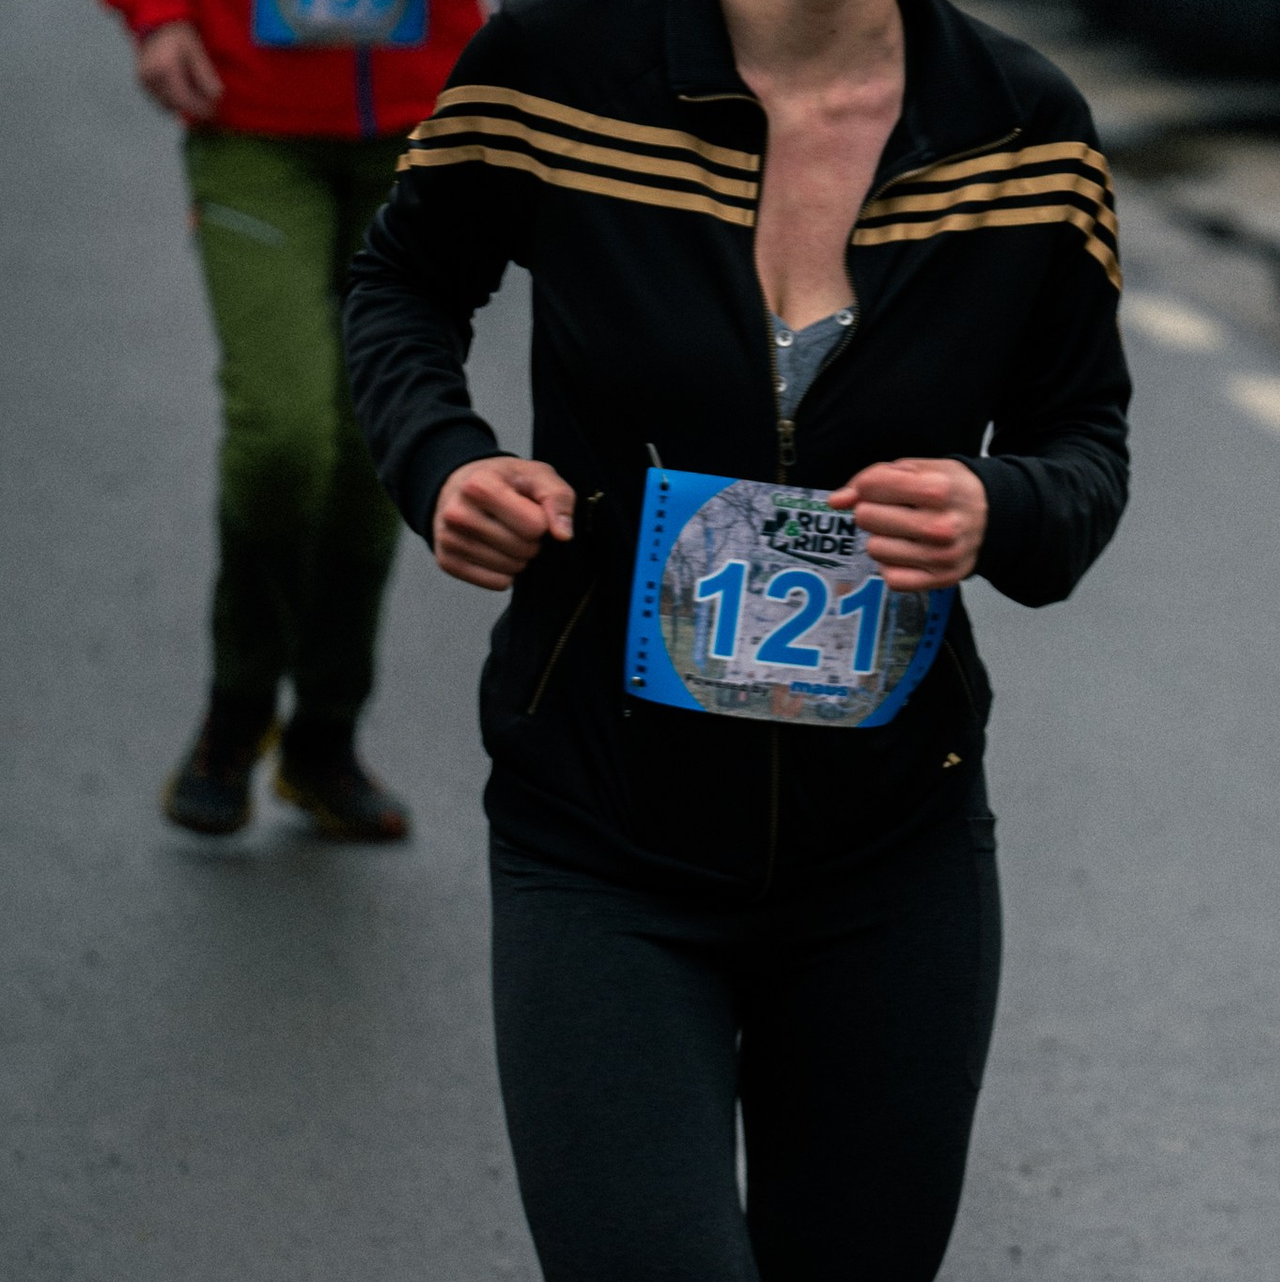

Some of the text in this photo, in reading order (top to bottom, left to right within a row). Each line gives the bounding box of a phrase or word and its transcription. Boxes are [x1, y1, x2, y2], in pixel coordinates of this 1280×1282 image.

[797, 512, 857, 536] RUN
[794, 533, 854, 556] RIDE
[697, 561, 887, 674] 121
[790, 681, 849, 697] maus
